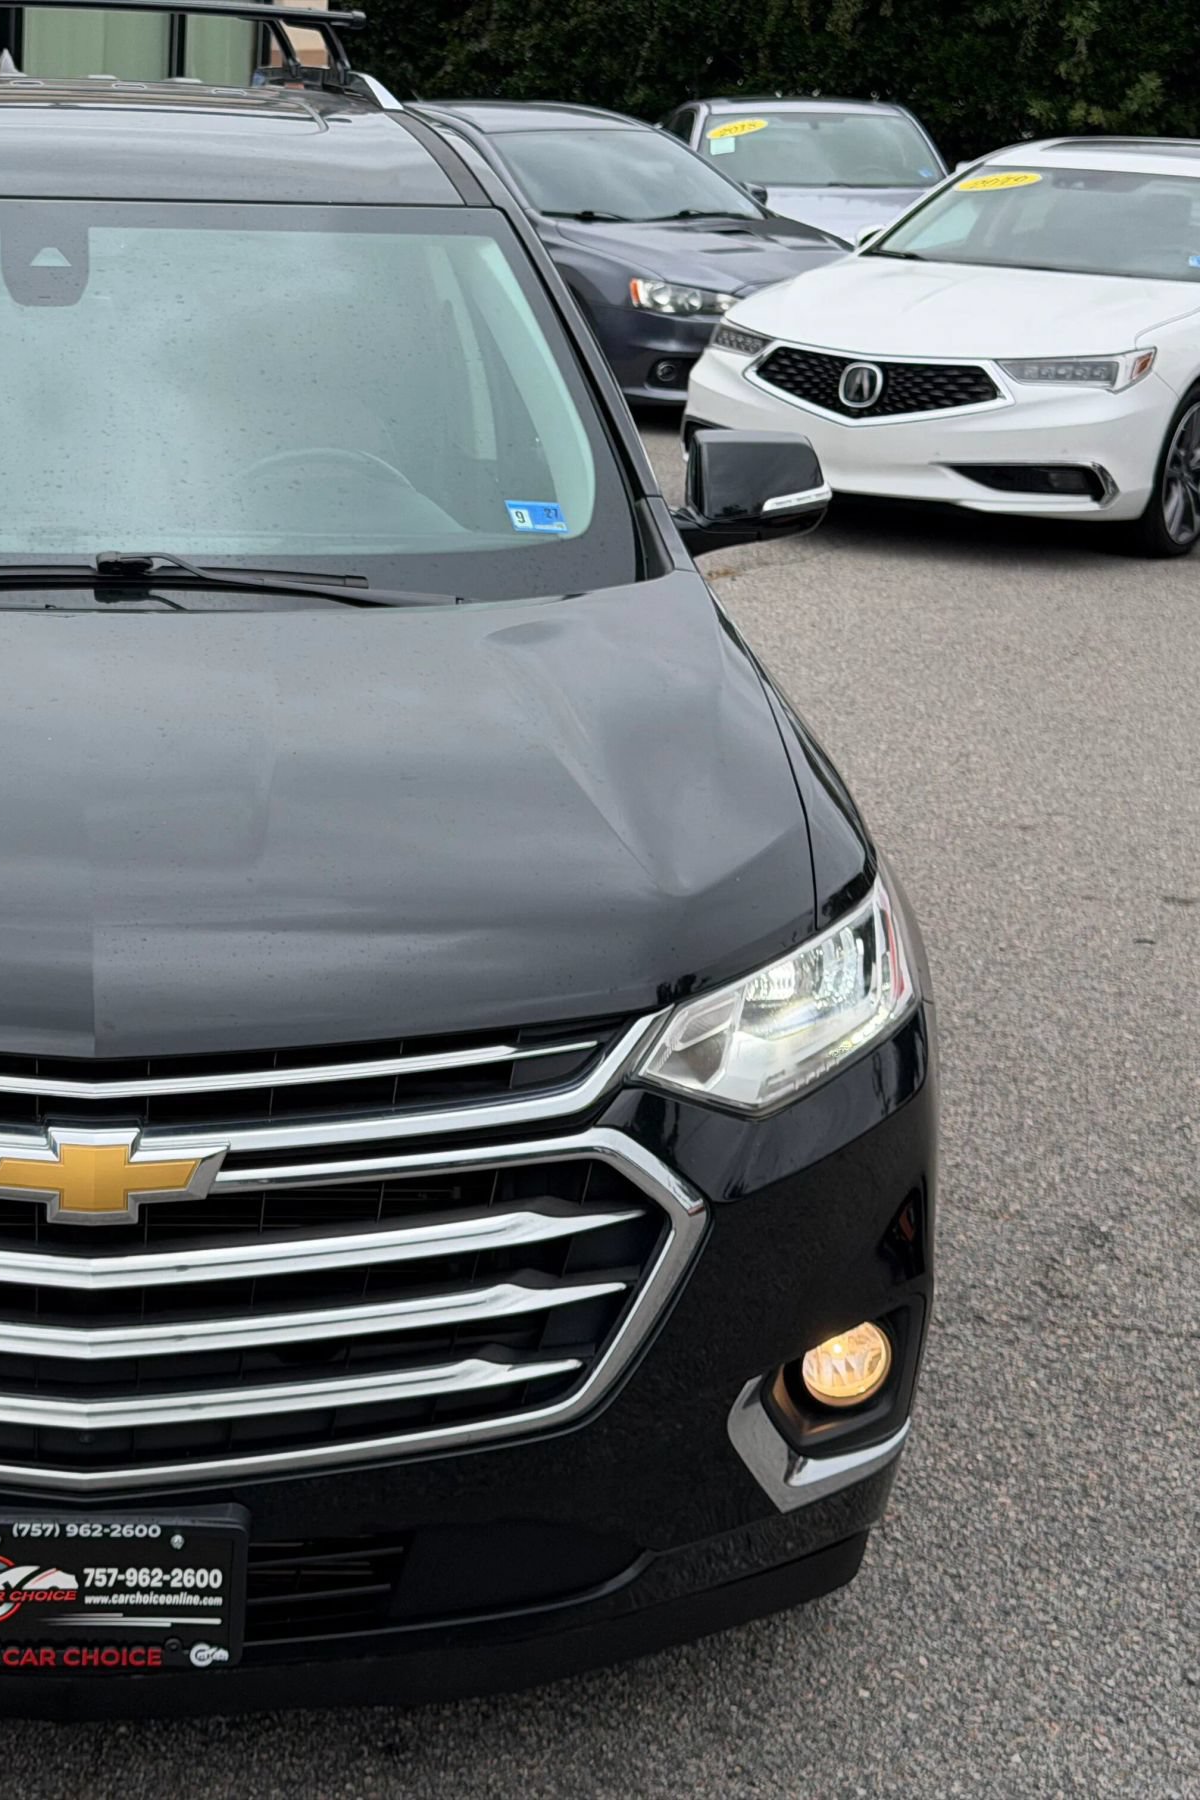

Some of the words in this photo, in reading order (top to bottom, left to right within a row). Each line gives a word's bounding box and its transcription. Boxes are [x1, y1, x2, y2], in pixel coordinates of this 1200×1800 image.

[514, 510, 526, 524] 9
[12, 1522, 60, 1538] (757)
[65, 1523, 162, 1538] 962-2600
[83, 1567, 223, 1589] 757-962-2600
[9, 1590, 78, 1602] CHOICE
[84, 1590, 223, 1606] www.carchoiceonline.com
[2, 1646, 57, 1667] CAR
[63, 1646, 163, 1667] CHOICE
